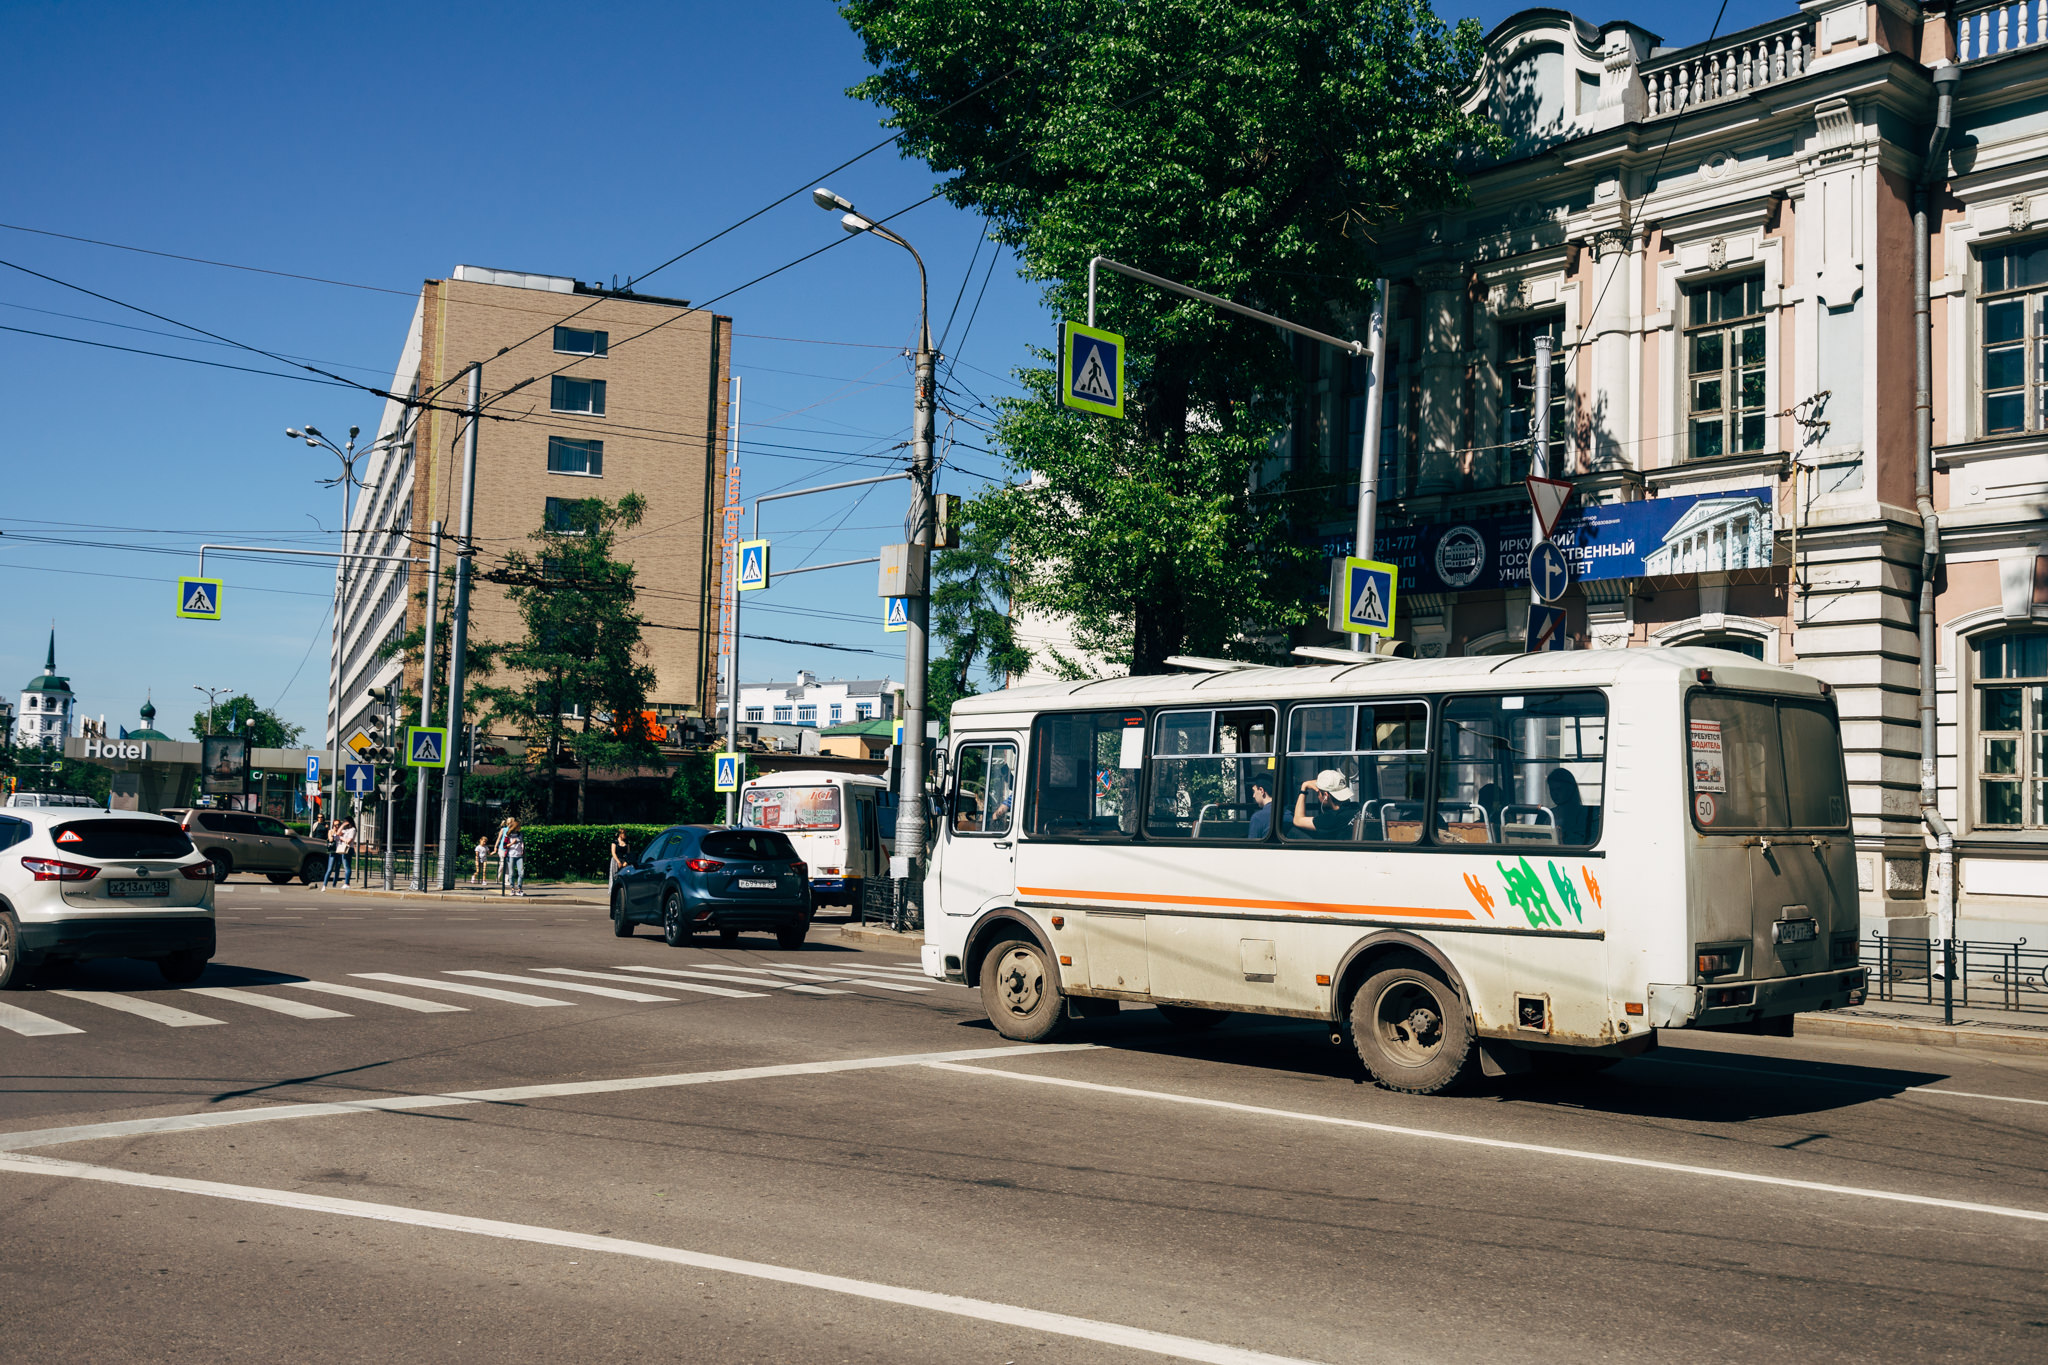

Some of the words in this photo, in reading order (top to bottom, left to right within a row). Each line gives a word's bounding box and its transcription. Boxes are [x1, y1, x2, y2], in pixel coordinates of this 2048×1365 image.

[729, 466, 741, 506] КЛУБ
[1499, 530, 1576, 552] ИРКУКИЙ
[1499, 539, 1636, 567] ГОСУСТВЕННЫЙ
[1498, 561, 1594, 582] УНИВТЕТ
[1690, 732, 1720, 741] ТРЕБУЕТСЯ
[1691, 740, 1721, 750] ВОДИТЕЛЬ
[84, 739, 147, 760] Hotel
[1699, 801, 1712, 816] 50
